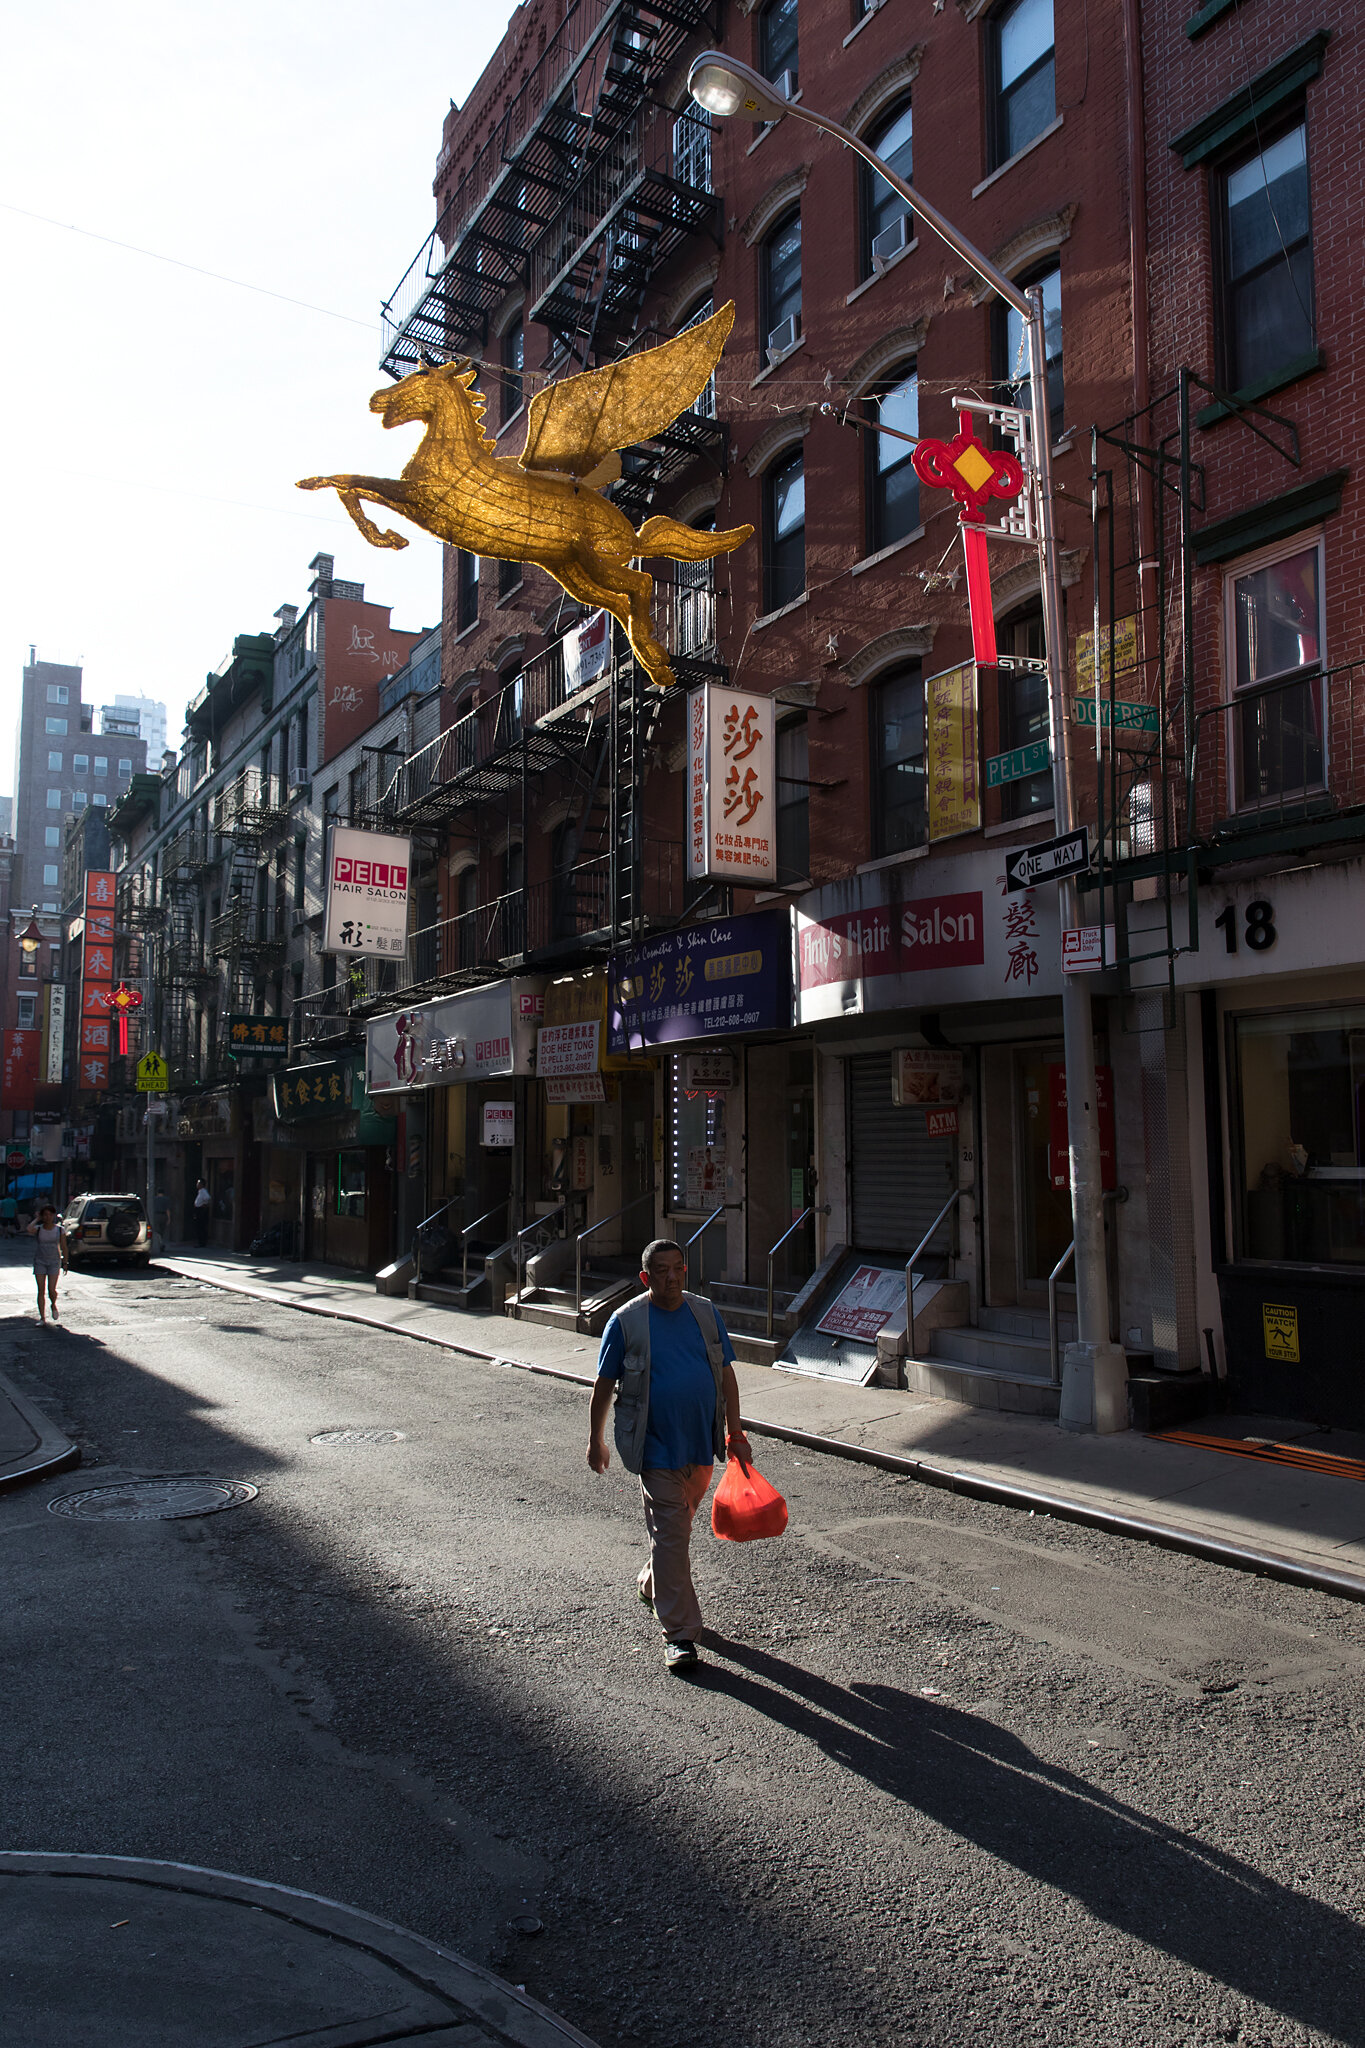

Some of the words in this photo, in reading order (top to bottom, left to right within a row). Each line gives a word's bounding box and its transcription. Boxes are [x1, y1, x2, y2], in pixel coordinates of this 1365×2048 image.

[722, 704, 764, 827] 莎莎
[988, 752, 1032, 784] PELL
[1032, 745, 1045, 760] ST
[715, 832, 769, 851] 化妝品專門店
[715, 848, 770, 868] 美容減肥中心
[1018, 856, 1043, 878] ONE
[1053, 844, 1077, 867] WAY
[336, 859, 404, 888] PELL
[333, 882, 362, 894] HAIR
[367, 887, 407, 901] SALON
[803, 927, 842, 967] Amy's
[847, 917, 890, 957] Hair
[901, 906, 975, 948] Salon
[1082, 931, 1098, 939] Truck
[1215, 900, 1276, 953] 18
[642, 942, 672, 961] Cosmetic
[677, 935, 684, 949] &
[687, 931, 707, 950] Skin
[710, 927, 733, 945] Care
[84, 877, 113, 1085] 喜運來大酒家
[649, 955, 695, 1004] 莎莎
[232, 1022, 286, 1043] 佛有緣
[476, 1038, 510, 1061] PELL
[541, 1044, 556, 1055] DOE
[558, 1042, 572, 1053] HEE
[574, 1039, 594, 1051] TONG
[141, 1081, 165, 1089] AHEAD
[281, 1073, 342, 1108] 素食之家
[486, 1109, 513, 1120] PELL
[929, 1112, 957, 1130] ATM
[963, 1151, 973, 1161] 20
[602, 1164, 615, 1177] 22
[1265, 1307, 1295, 1318] CAUTION
[1267, 1317, 1295, 1327] WATCH
[1269, 1348, 1283, 1356] YOUR
[1284, 1350, 1297, 1359] STEP
